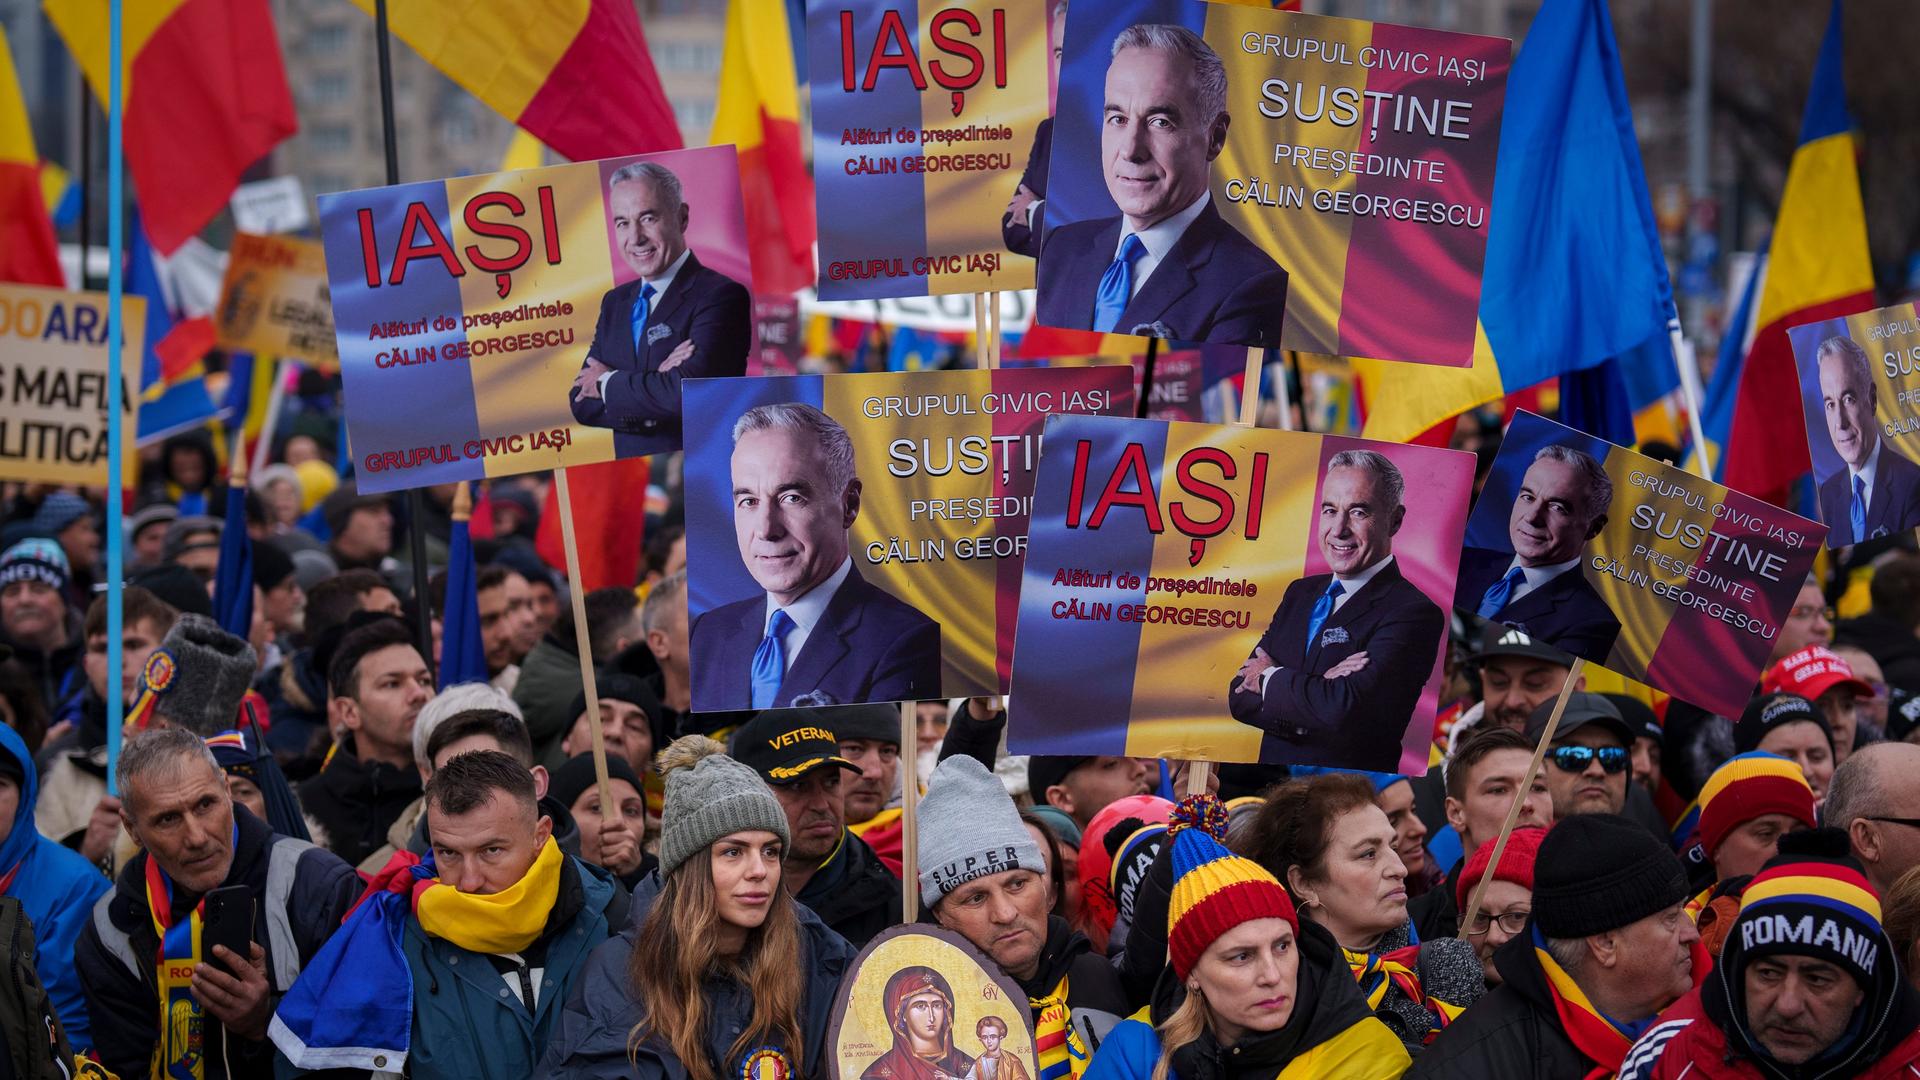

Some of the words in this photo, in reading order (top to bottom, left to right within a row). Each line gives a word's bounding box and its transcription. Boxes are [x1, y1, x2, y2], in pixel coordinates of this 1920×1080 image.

[840, 8, 1007, 117] IAȘI
[1241, 32, 1353, 65] GRUPUL
[1358, 47, 1429, 74] CIVIC
[1437, 56, 1486, 86] IAȘI
[1258, 78, 1473, 141] SUSȚINE
[841, 126, 892, 146] Alături
[896, 126, 916, 144] de
[920, 124, 1013, 147] președintele
[844, 155, 898, 176] CĂLIN
[901, 153, 1011, 173] GEORGESCU
[1274, 144, 1445, 183] PREȘEDINTE
[1225, 177, 1304, 208] CĂLIN
[1312, 189, 1485, 228] GEORGESCU
[357, 185, 562, 299] IAȘI
[828, 258, 909, 280] GRUPUL
[912, 254, 961, 275] CIVIC
[966, 252, 1001, 277] IAȘI
[369, 314, 428, 341] Alături
[432, 312, 457, 332] de
[461, 300, 574, 331] președintele
[1866, 320, 1914, 342] GRUPUL
[374, 345, 437, 369] CĂLIN
[440, 327, 575, 361] GEORGESCU
[862, 395, 976, 418] GRUPUL
[981, 391, 1053, 414] CIVIC
[1061, 389, 1111, 416] IAȘI
[365, 441, 460, 473] GRUPUL
[463, 434, 525, 460] CIVIC
[529, 427, 572, 453] IAȘI
[911, 496, 1034, 525] PREȘEDI
[1065, 440, 1269, 567] IAȘI
[1629, 470, 1707, 512] GRUPUL
[1711, 503, 1764, 533] CIVIC
[1767, 524, 1806, 550] IAȘI
[866, 537, 945, 564] CĂLIN
[1630, 504, 1788, 583] SUSȚINE
[1052, 568, 1112, 589] Alături
[1117, 571, 1142, 590] de
[1145, 573, 1258, 599] președintele
[1632, 544, 1756, 603] PREȘEDINTE
[1051, 599, 1112, 621] CĂLIN
[1116, 604, 1251, 630] GEORGESCU
[1591, 555, 1649, 588] CĂLIN
[1652, 580, 1776, 640] GEORGESCU
[768, 727, 837, 750] VETERAN
[932, 846, 1019, 884] SUPER
[1741, 914, 1877, 976] ROMANIA
